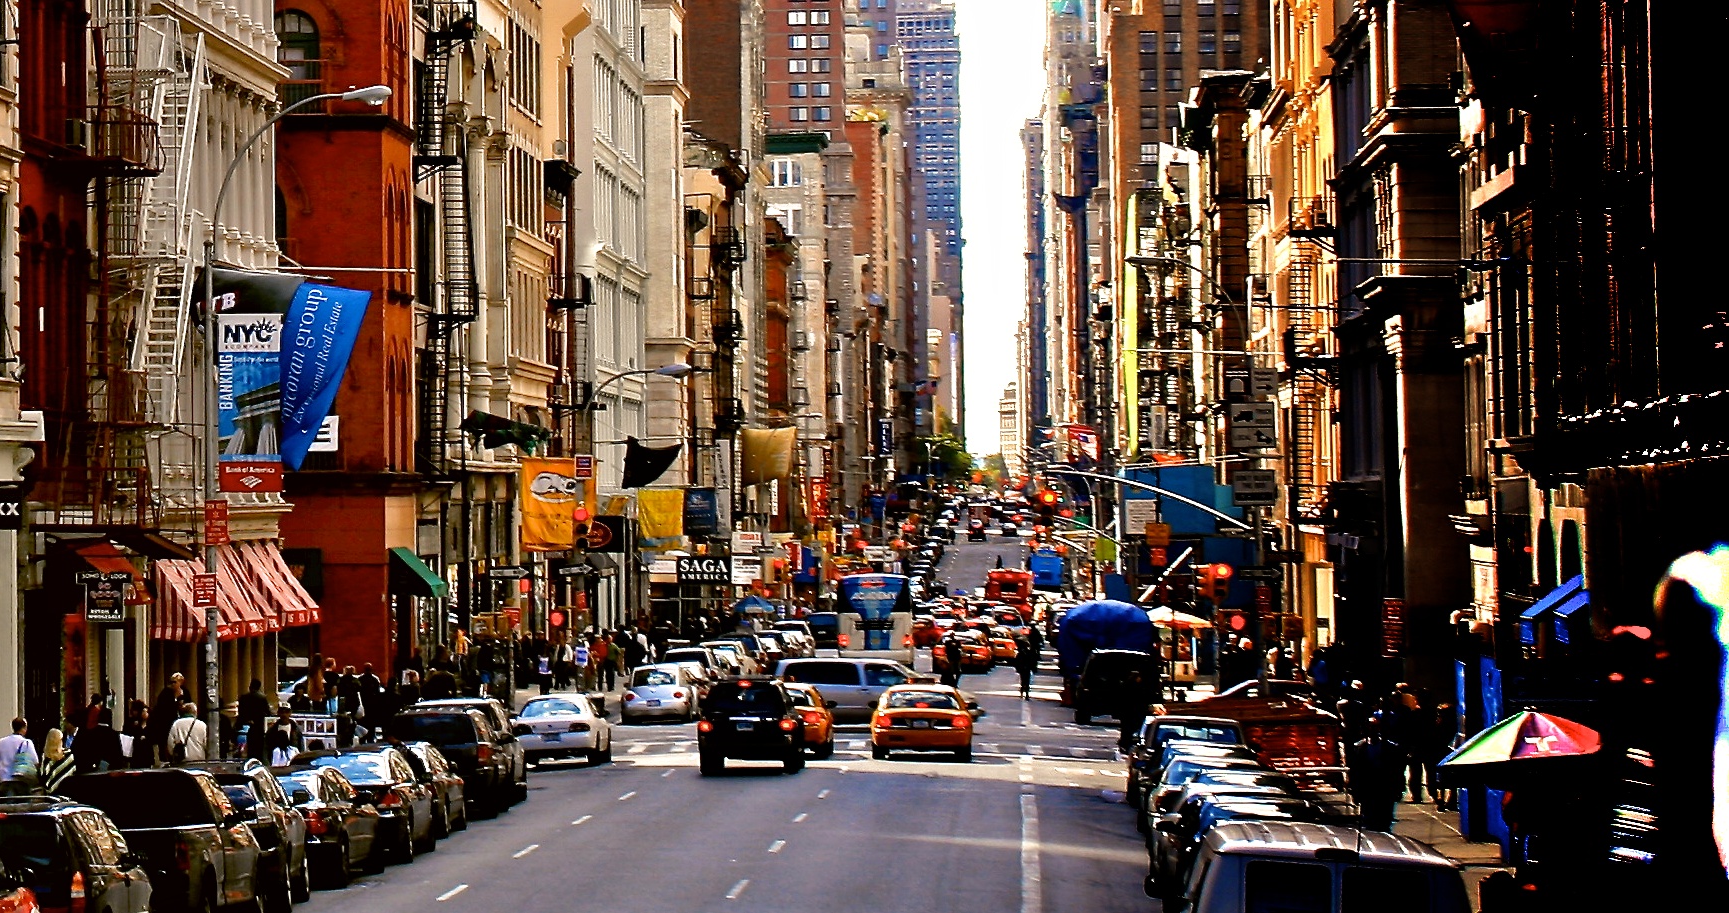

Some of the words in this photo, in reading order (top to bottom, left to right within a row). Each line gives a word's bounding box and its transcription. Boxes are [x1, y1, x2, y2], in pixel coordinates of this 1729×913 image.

[296, 287, 329, 350] group
[323, 300, 344, 335] Estate
[223, 322, 274, 344] NYC
[316, 334, 334, 363] Real
[219, 354, 234, 410] BANKING
[225, 466, 242, 474] Bank
[250, 466, 275, 476] America
[679, 558, 728, 573] SAGA
[680, 573, 729, 581] AMERICA
